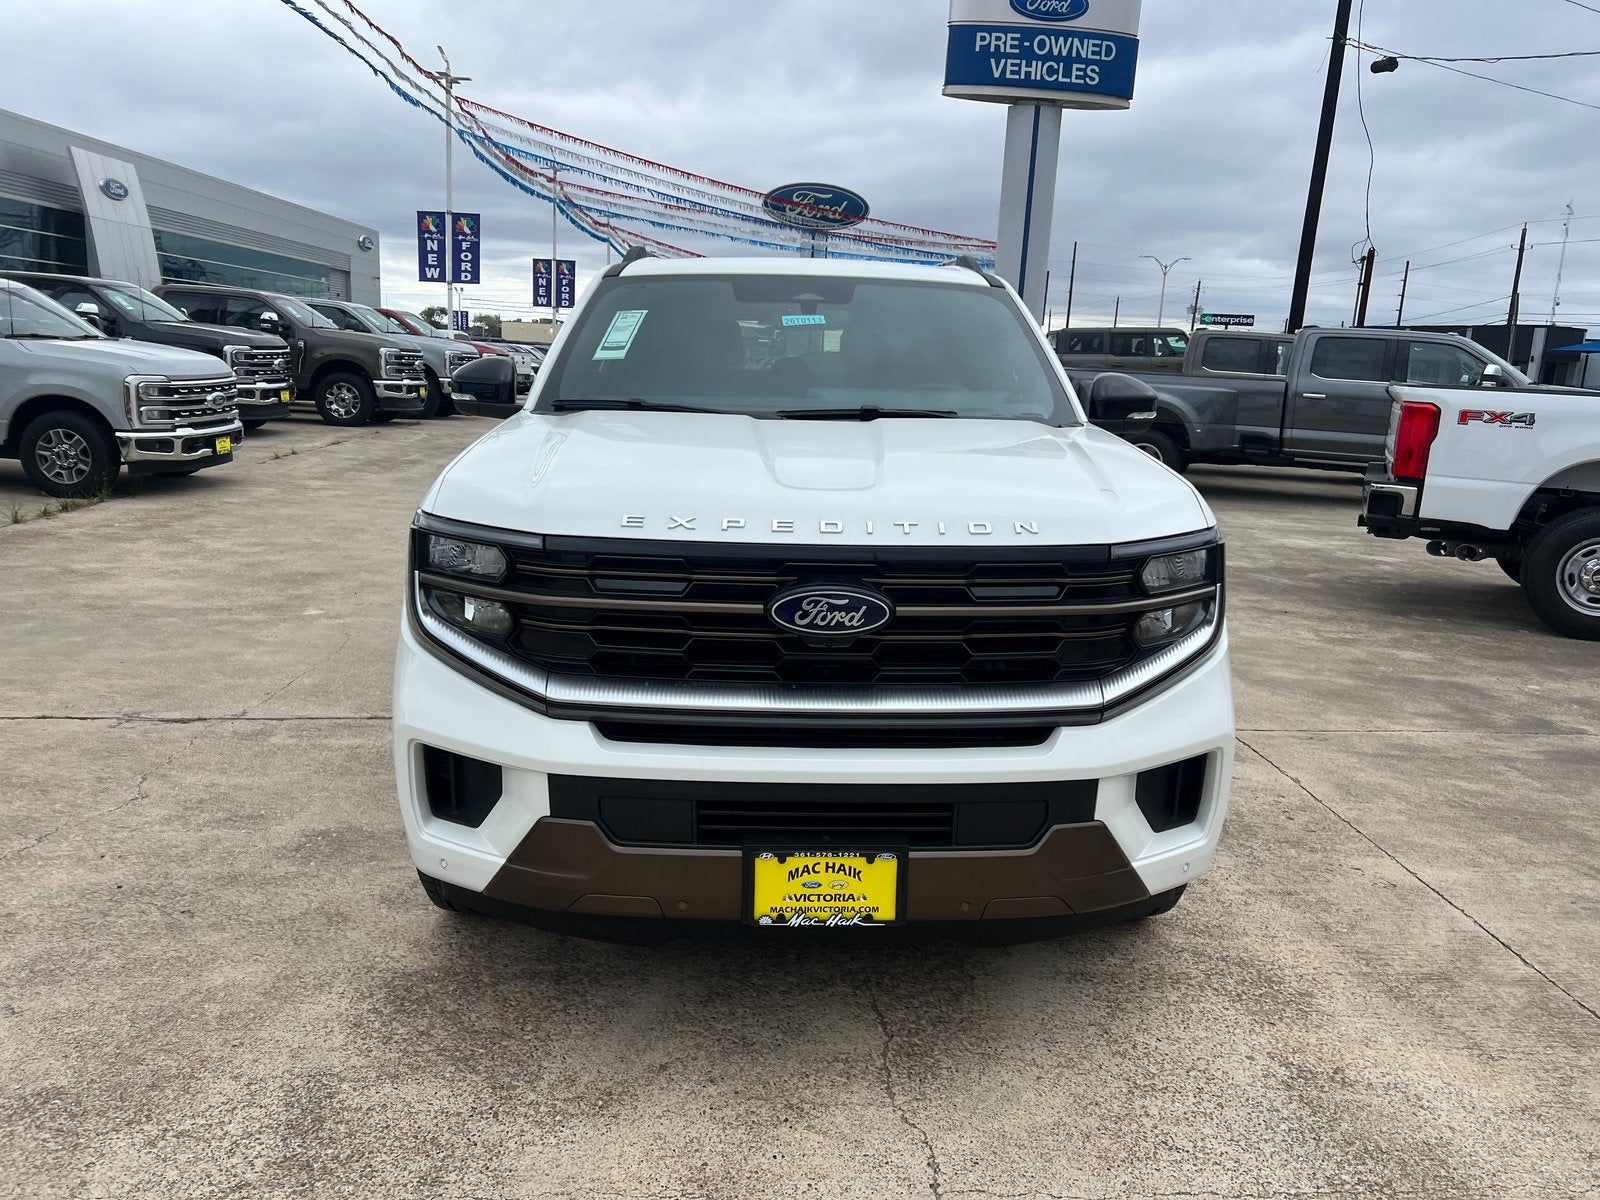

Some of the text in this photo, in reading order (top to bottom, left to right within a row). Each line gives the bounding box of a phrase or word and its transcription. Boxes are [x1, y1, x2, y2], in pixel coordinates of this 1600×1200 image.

[975, 32, 1117, 61] PRE-OWNED
[990, 58, 1100, 86] VEHICLES
[108, 181, 126, 196] Ford
[786, 190, 848, 219] Ford
[425, 240, 440, 279] NEW
[461, 242, 472, 281] FORD
[537, 278, 547, 305] NEW
[560, 280, 569, 307] FORD
[1202, 316, 1254, 325] enterprise
[1457, 409, 1536, 426] FX4
[621, 513, 1040, 536] EXPEDITION
[794, 596, 866, 628] Ford
[787, 861, 863, 883] MAC HAIK
[769, 905, 880, 914] MACHAIKVICTORIA.COM
[794, 893, 856, 903] VICTORIA
[787, 912, 863, 928] Mac Haik
